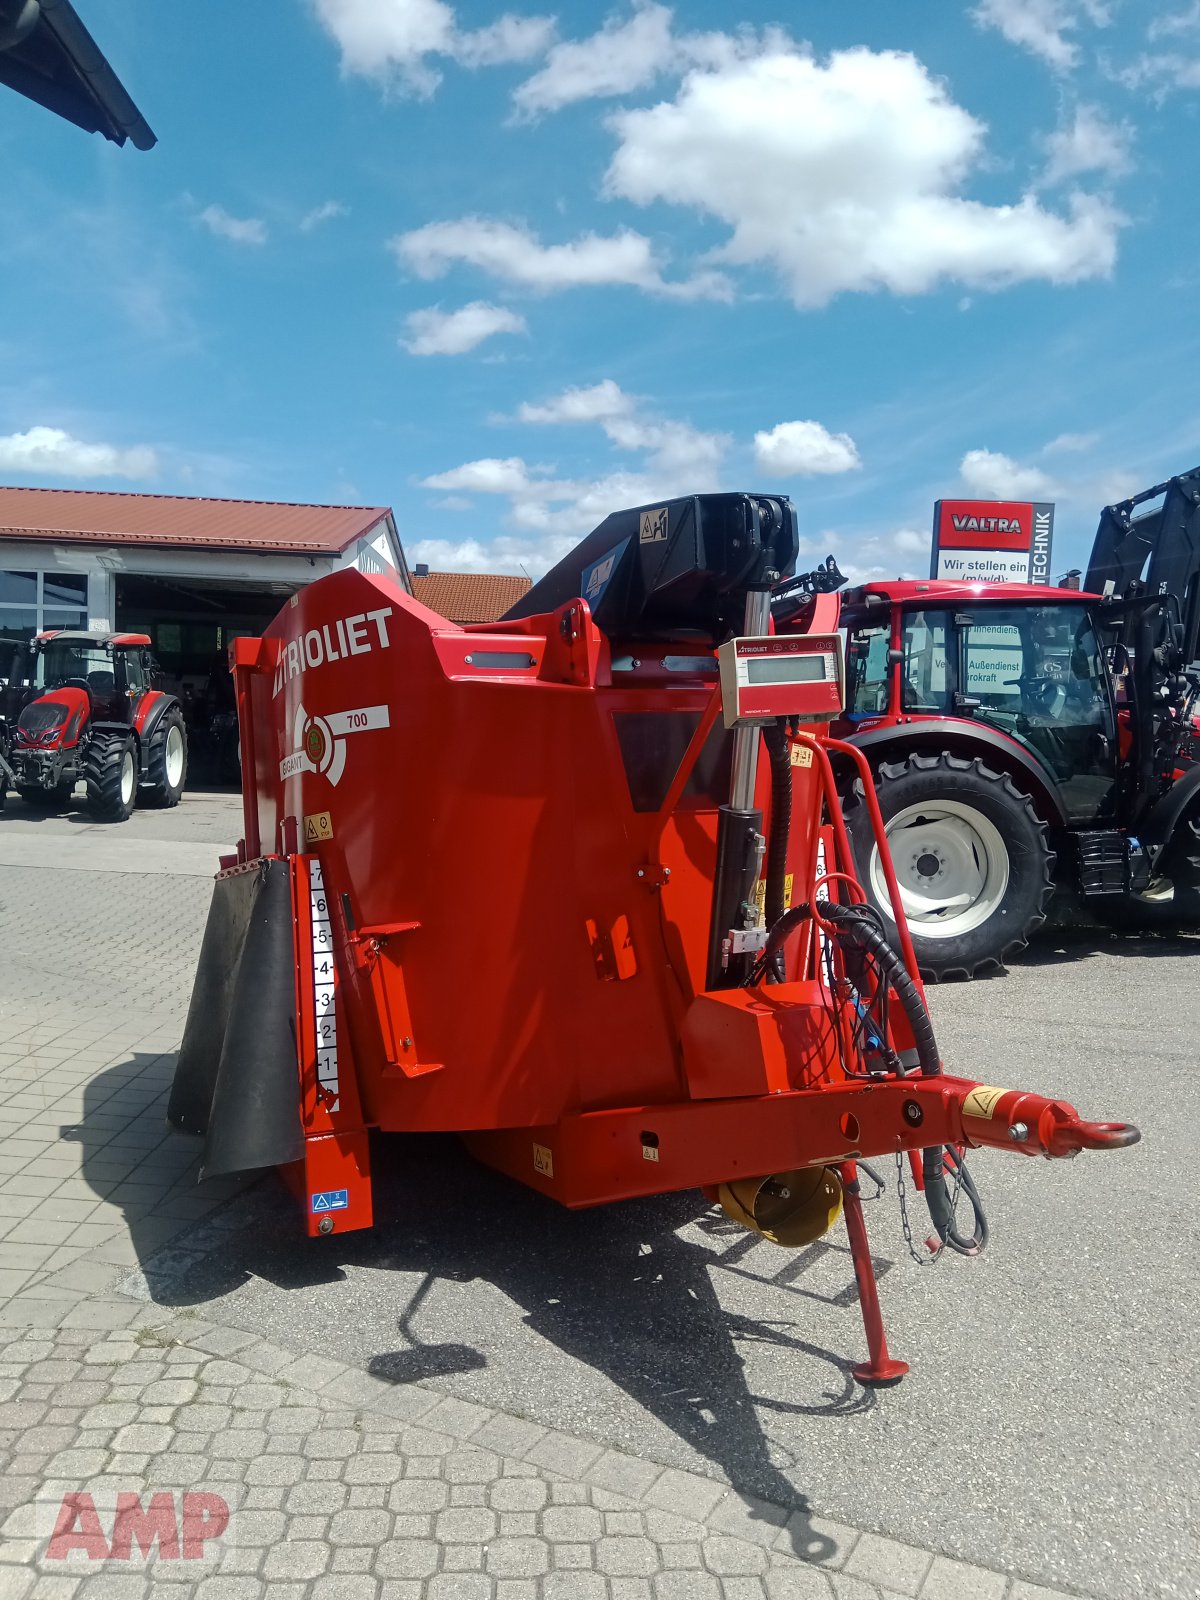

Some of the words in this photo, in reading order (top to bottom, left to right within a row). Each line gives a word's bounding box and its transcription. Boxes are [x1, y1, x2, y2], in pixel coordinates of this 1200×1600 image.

[951, 514, 1022, 534] VALTRA
[944, 560, 965, 570] Wir
[968, 561, 1006, 571] stellen
[1010, 562, 1027, 572] ein
[281, 606, 393, 685] TRIOLIET
[969, 660, 1020, 671] Außendienst
[346, 712, 368, 729] 700
[282, 755, 303, 775] GIGANT
[816, 864, 823, 875] 6
[818, 889, 826, 901] 5
[316, 898, 326, 912] 6
[318, 929, 328, 943] 5
[319, 961, 329, 975] 4
[321, 993, 330, 1006] 3
[322, 1025, 332, 1039] 2
[323, 1057, 330, 1070] 1
